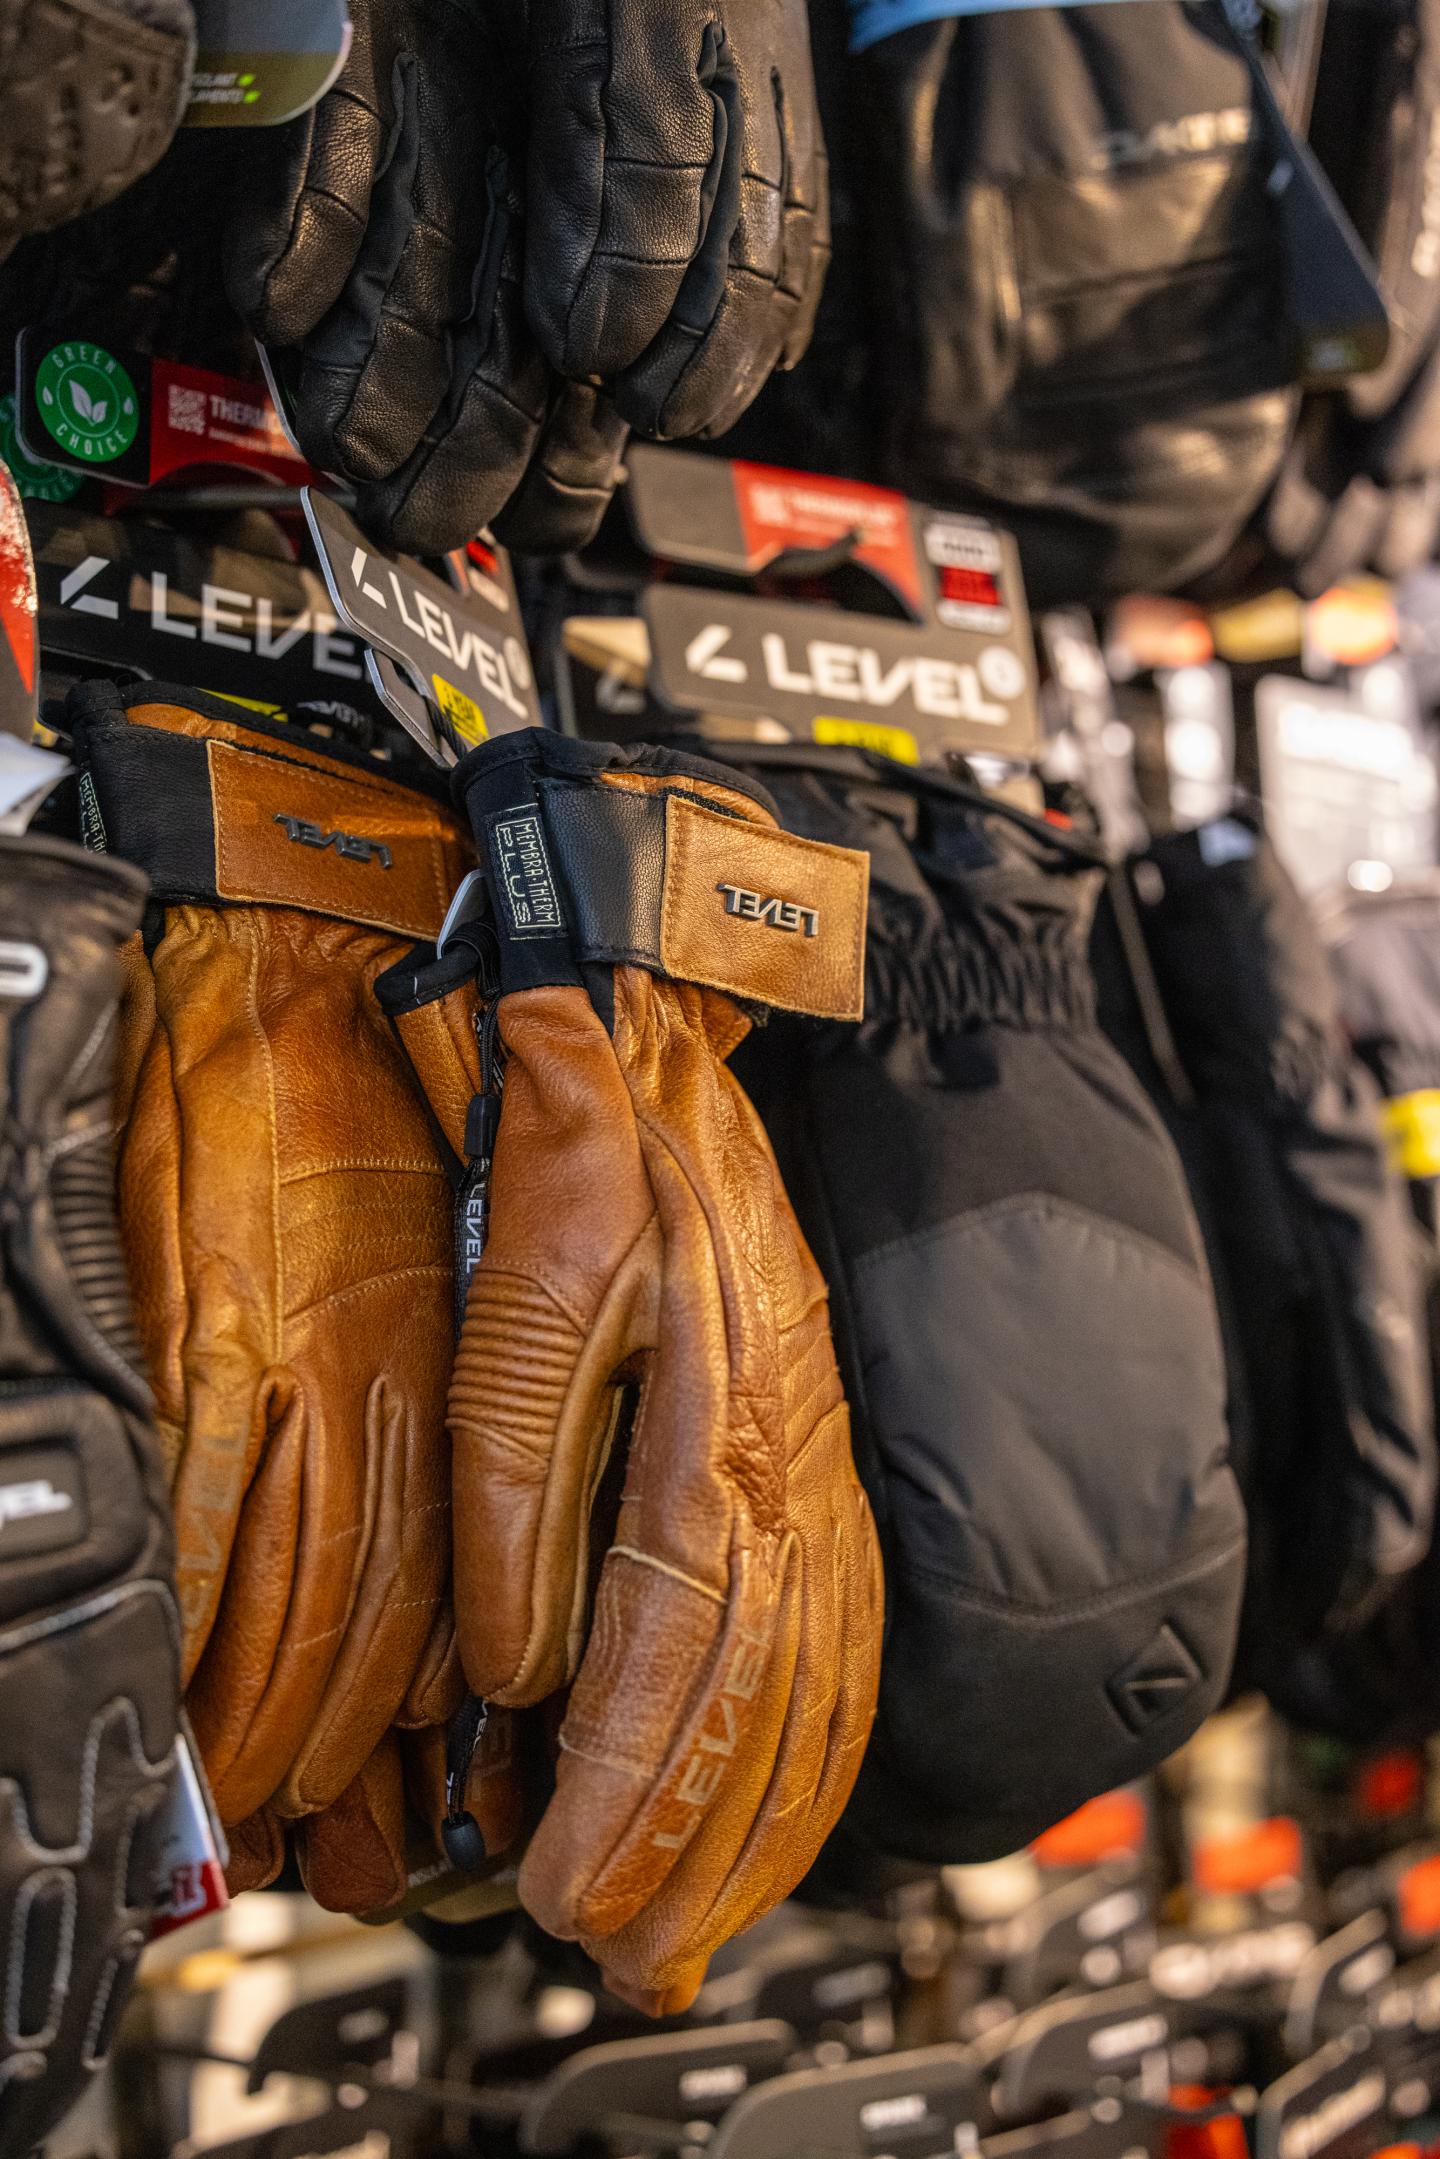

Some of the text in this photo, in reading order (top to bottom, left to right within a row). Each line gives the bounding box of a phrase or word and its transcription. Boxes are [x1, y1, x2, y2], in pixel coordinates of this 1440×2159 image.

[52, 345, 117, 374] GREEN
[56, 422, 129, 456] CHOICE
[152, 571, 373, 683] LEVE
[388, 570, 529, 720] LEVEL
[761, 632, 1009, 727] LEVEL
[273, 812, 393, 870] LEVEL
[500, 827, 532, 923] PLUS
[716, 882, 819, 938] LEVEL
[466, 1182, 487, 1274] LEVEL
[653, 1612, 772, 1849] LEVEL
